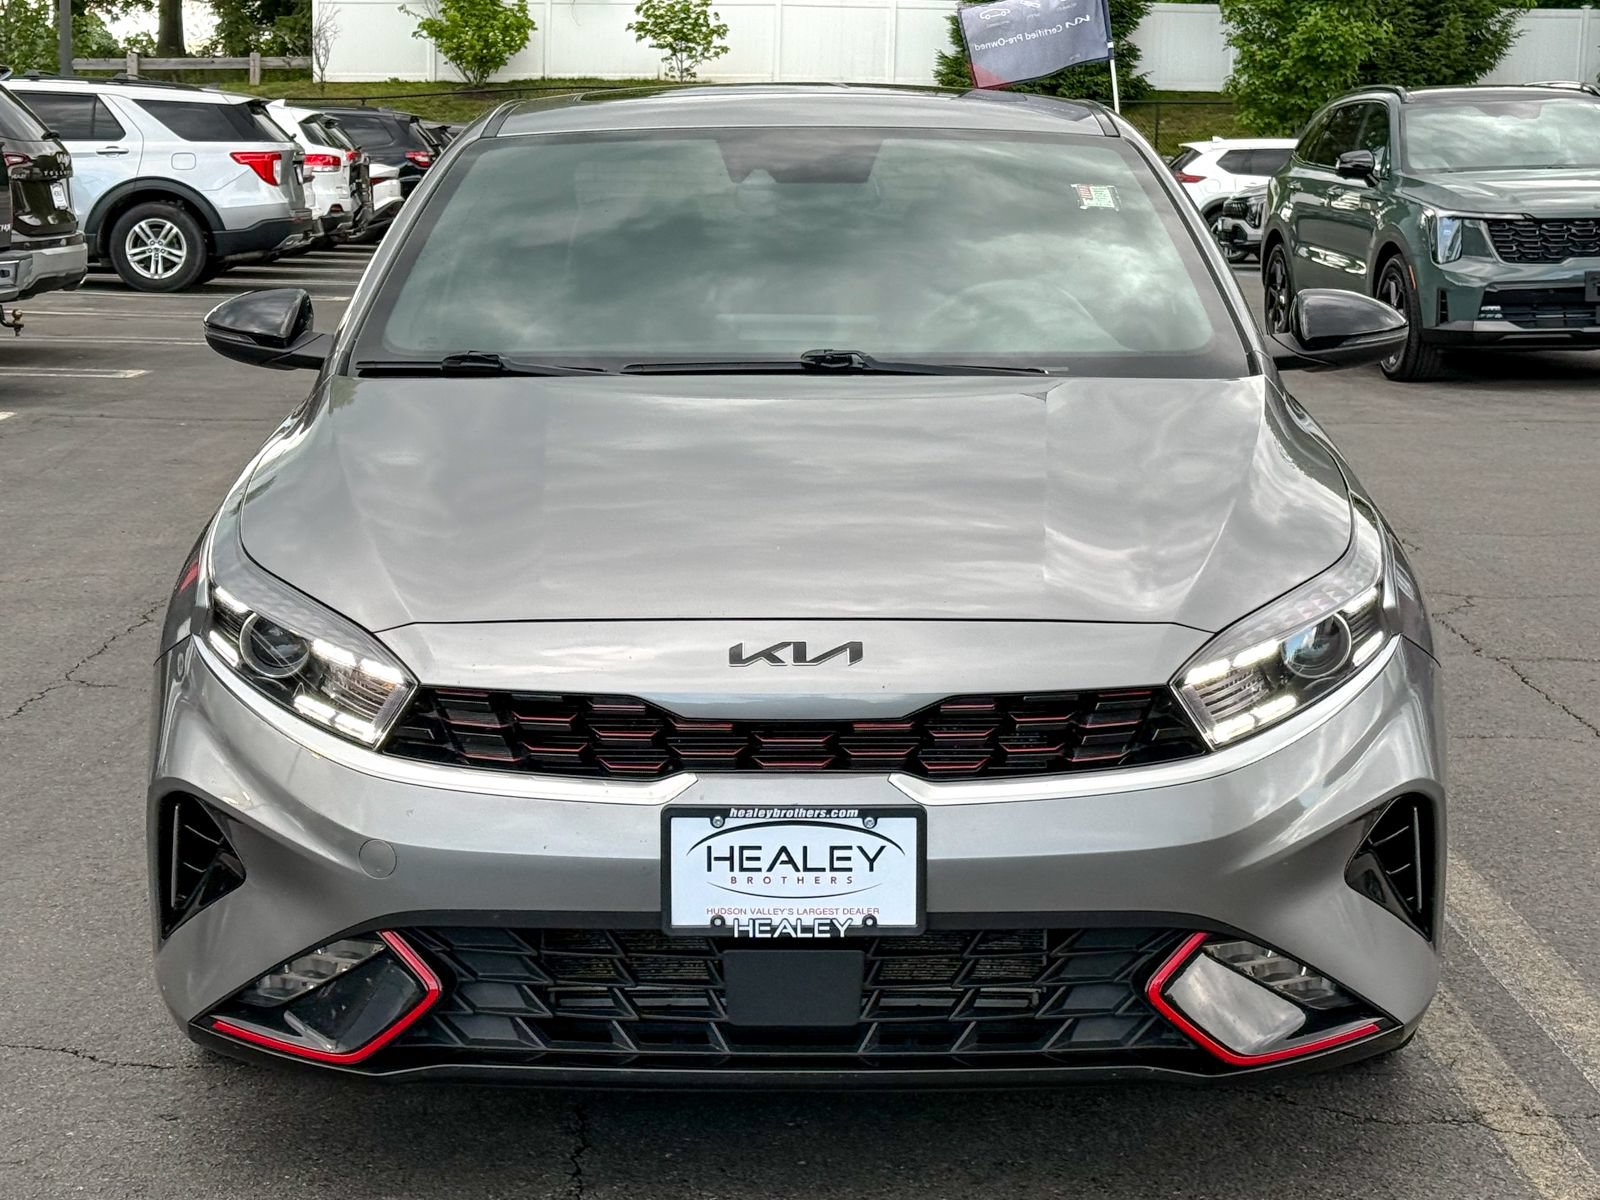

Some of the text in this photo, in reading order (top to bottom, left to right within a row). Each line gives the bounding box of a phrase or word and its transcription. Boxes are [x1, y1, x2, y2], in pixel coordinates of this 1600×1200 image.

[729, 641, 863, 667] KIA
[730, 808, 859, 818] healeybrothers.com
[706, 845, 887, 873] HEALEY
[730, 876, 853, 884] BROTHERS
[706, 907, 880, 916] HUDSON VALLEY'S LARGEST DEALER
[733, 918, 853, 938] HEALEY
